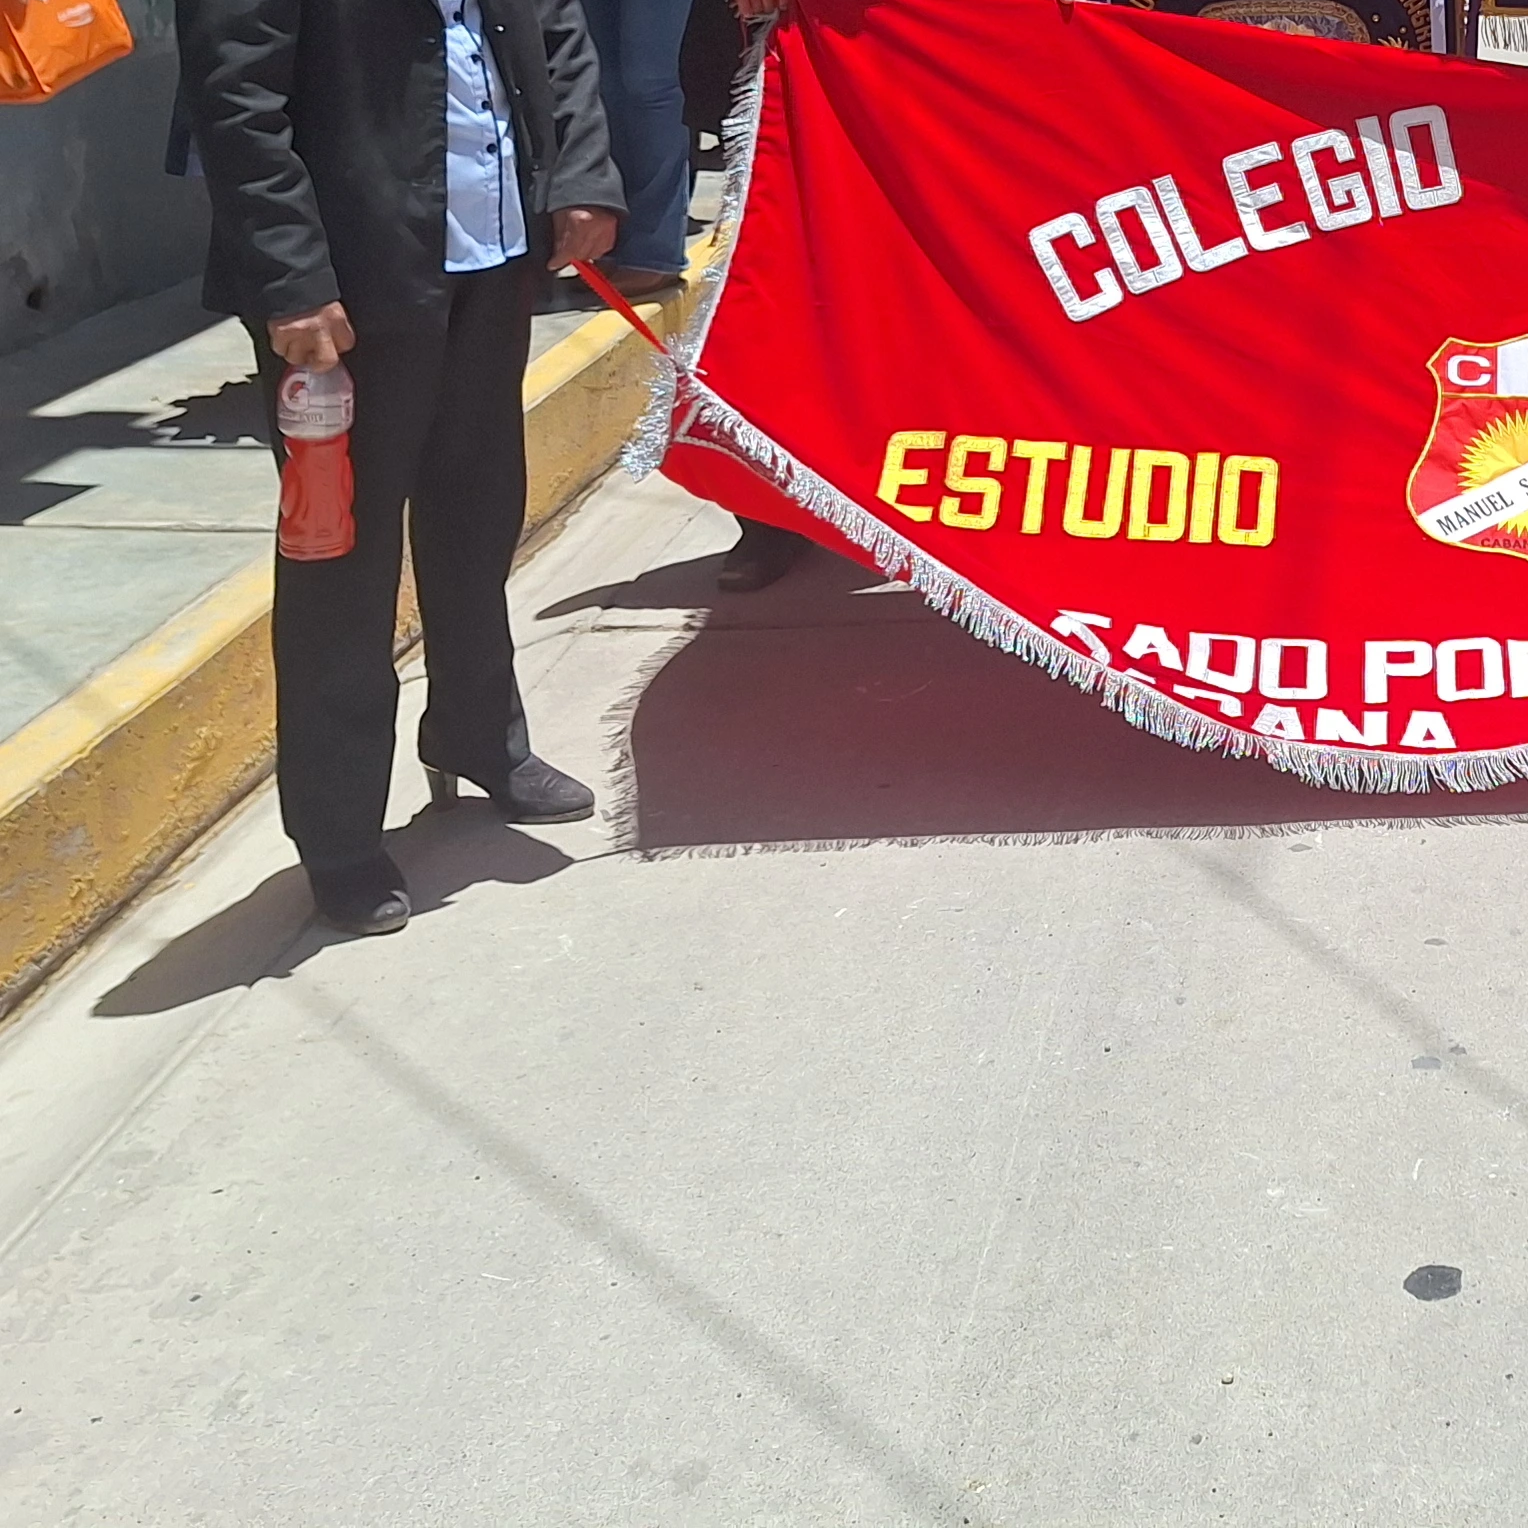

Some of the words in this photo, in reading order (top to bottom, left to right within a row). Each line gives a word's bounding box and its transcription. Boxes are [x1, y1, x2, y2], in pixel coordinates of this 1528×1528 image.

[1028, 104, 1463, 322] COLEGIO
[1447, 354, 1492, 387] C
[875, 430, 1279, 548] ESTUDIO
[1436, 490, 1515, 536] MANUEL
